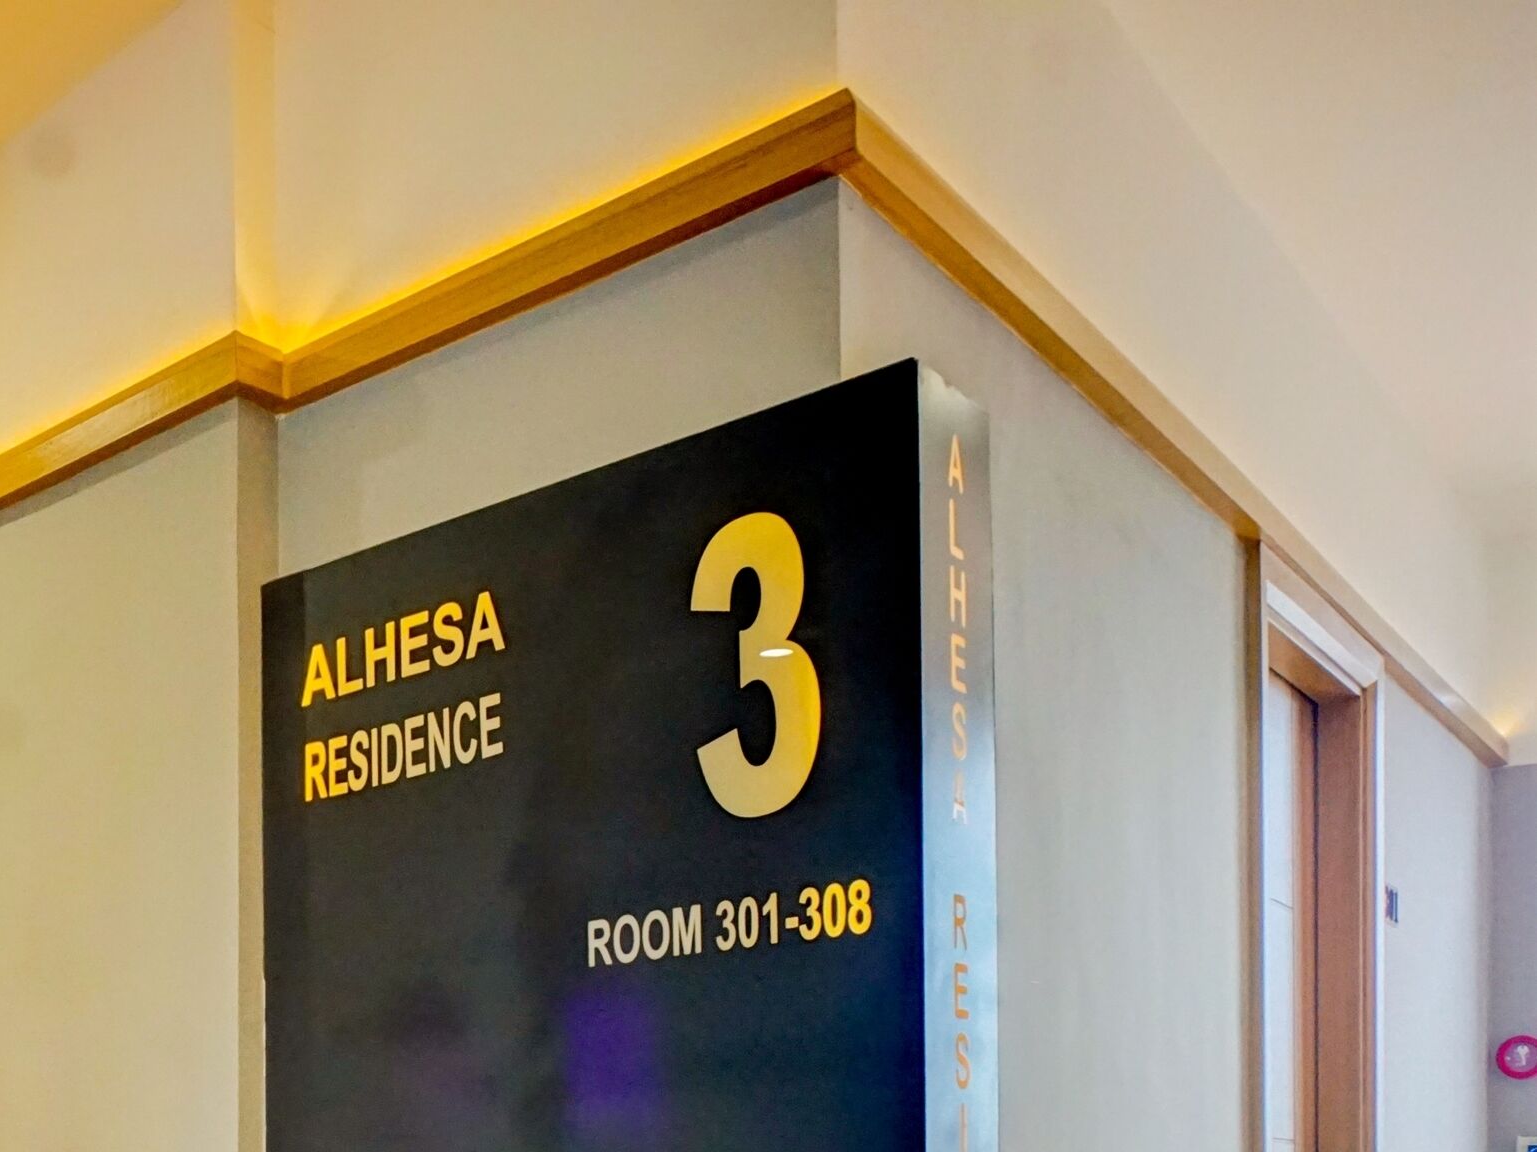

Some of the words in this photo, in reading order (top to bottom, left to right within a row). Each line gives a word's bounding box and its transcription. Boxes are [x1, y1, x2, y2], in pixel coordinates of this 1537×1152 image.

[301, 591, 506, 706] ALHESA
[690, 512, 821, 818] 3
[304, 692, 504, 802] RESIDENCE
[587, 904, 702, 968] ROOM
[715, 878, 872, 951] 301-308
